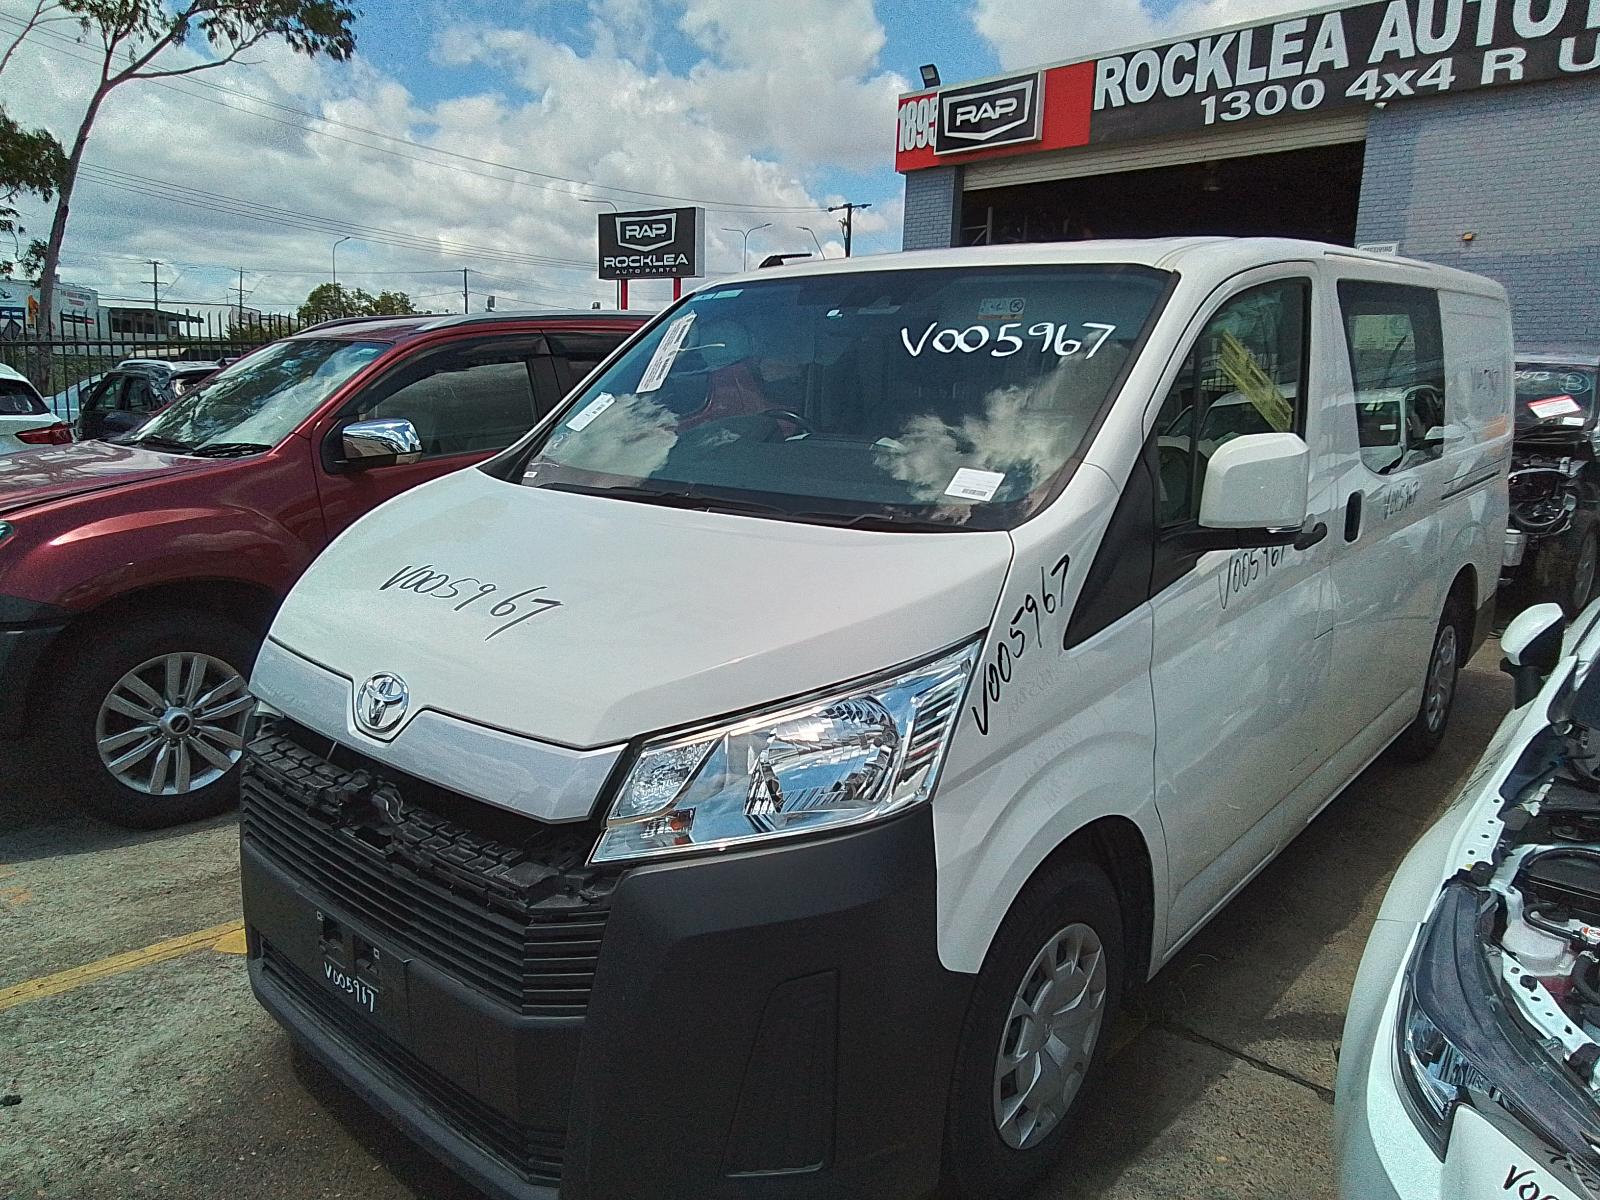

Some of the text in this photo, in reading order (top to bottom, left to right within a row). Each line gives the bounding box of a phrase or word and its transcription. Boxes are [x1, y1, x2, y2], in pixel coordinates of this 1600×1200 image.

[1093, 0, 1568, 111] ROCKLEA AUTO
[1200, 33, 1600, 126] 1300 4x4 R U
[955, 97, 1018, 127] RAP
[625, 222, 668, 240] RAP
[602, 253, 690, 269] ROCKLEA
[900, 321, 1118, 360] V005967
[378, 564, 565, 642] V005967
[971, 554, 1071, 736] V005967
[323, 961, 375, 1014] V005967
